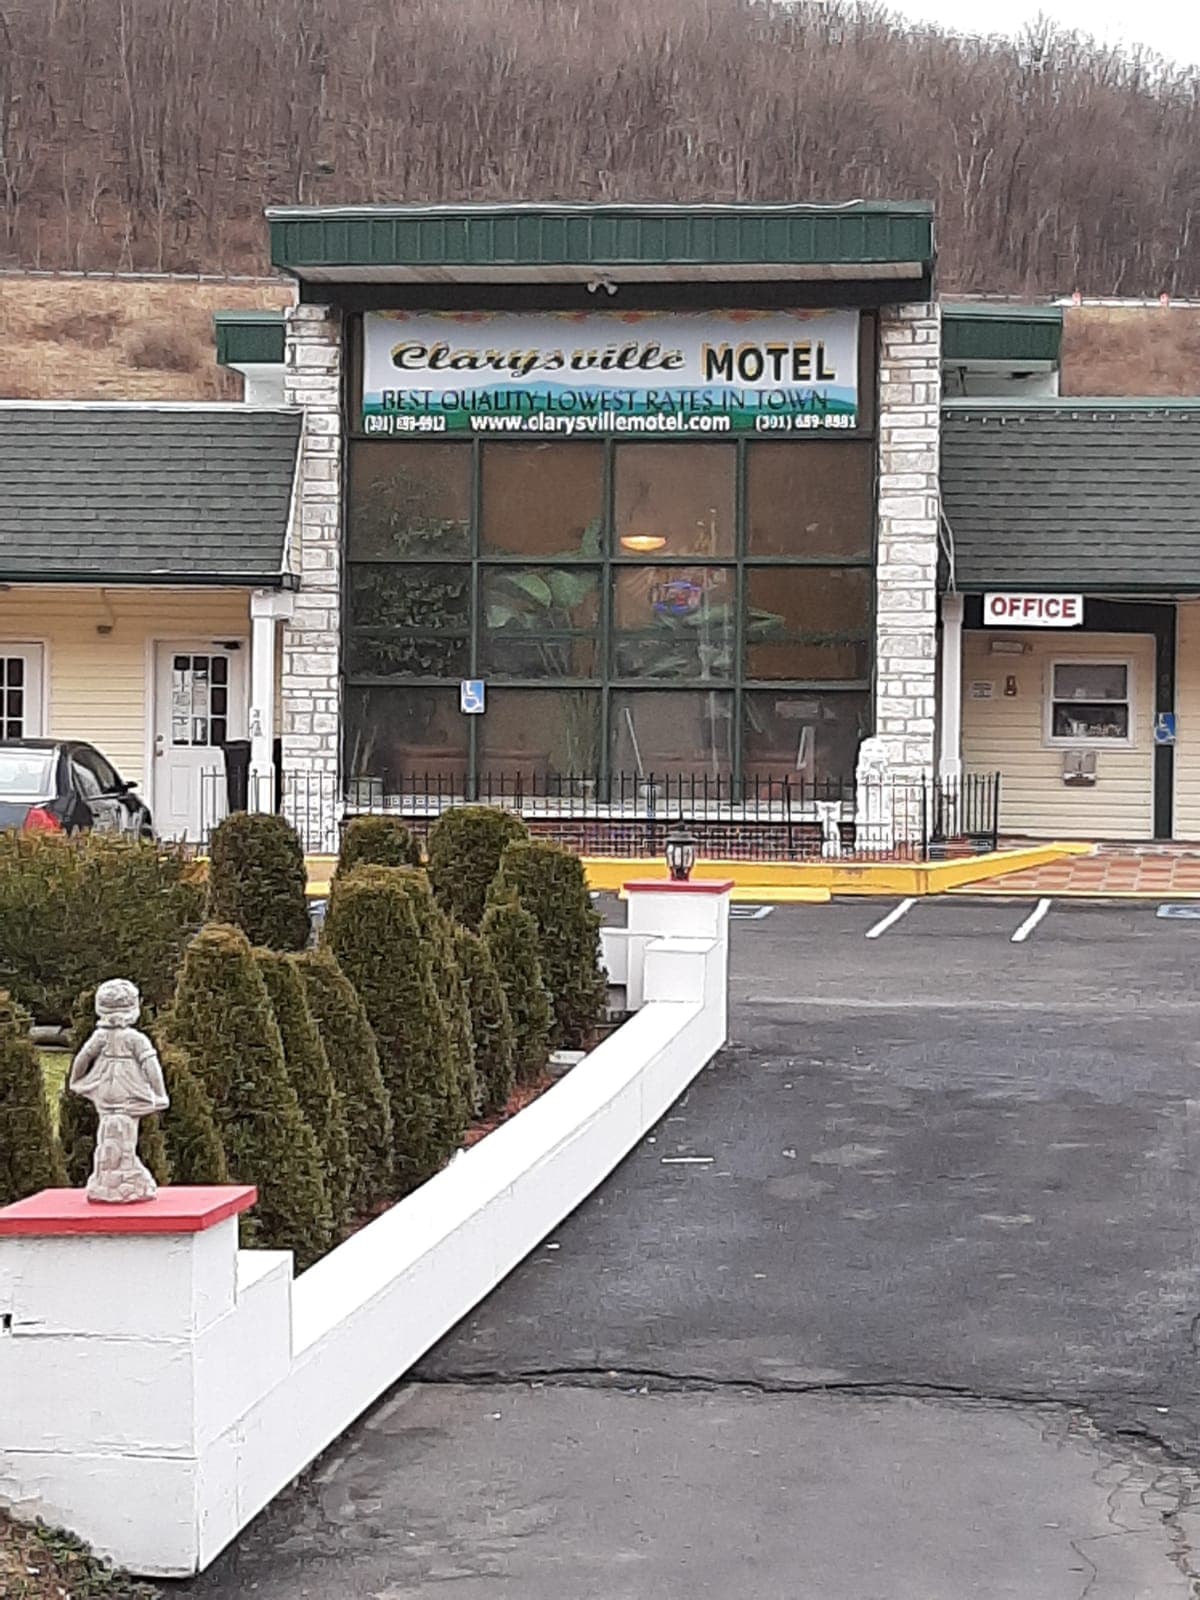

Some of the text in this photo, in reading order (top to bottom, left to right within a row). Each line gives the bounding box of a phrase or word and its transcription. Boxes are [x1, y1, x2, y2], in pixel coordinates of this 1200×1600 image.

[391, 341, 836, 382] Clarysville MOTEL
[383, 388, 828, 411] BEST QUALITY LOWEST RATES IN TOWN
[470, 411, 730, 434] www.clarysvillemotel.com
[755, 414, 792, 432] (301)
[990, 596, 1077, 618] OFFICE
